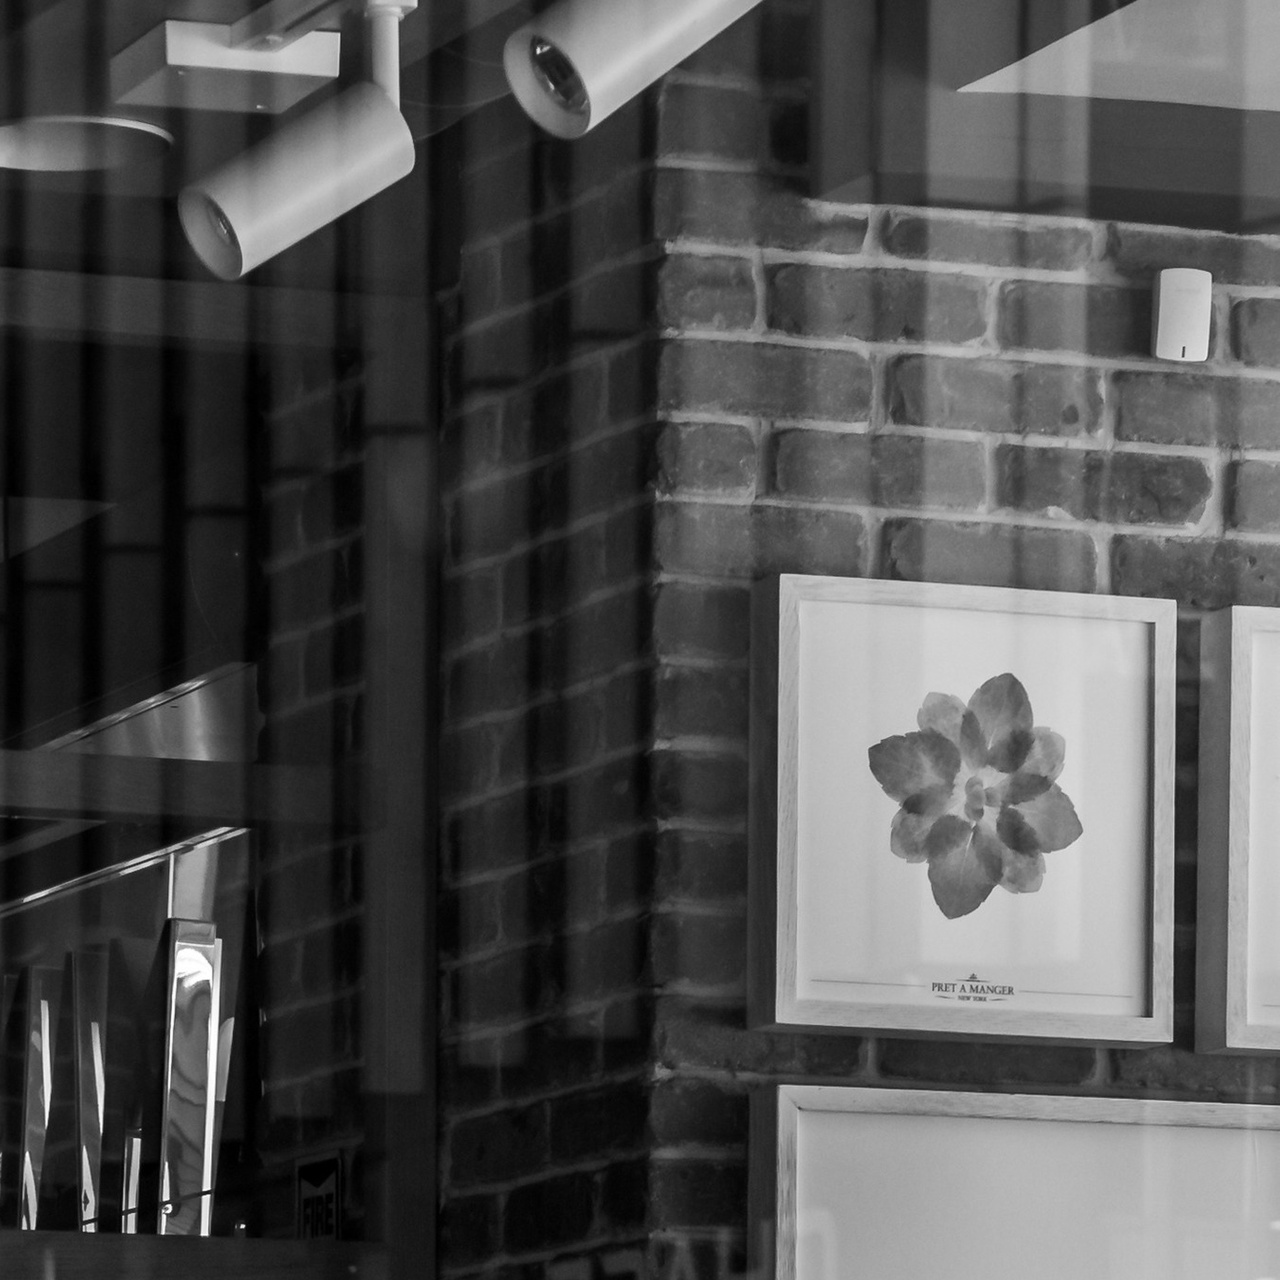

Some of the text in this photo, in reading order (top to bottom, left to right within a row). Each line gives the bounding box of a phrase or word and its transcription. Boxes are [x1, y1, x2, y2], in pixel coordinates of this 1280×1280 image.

[932, 982, 1014, 995] PRET A MANGER
[303, 1192, 334, 1238] FIRE
